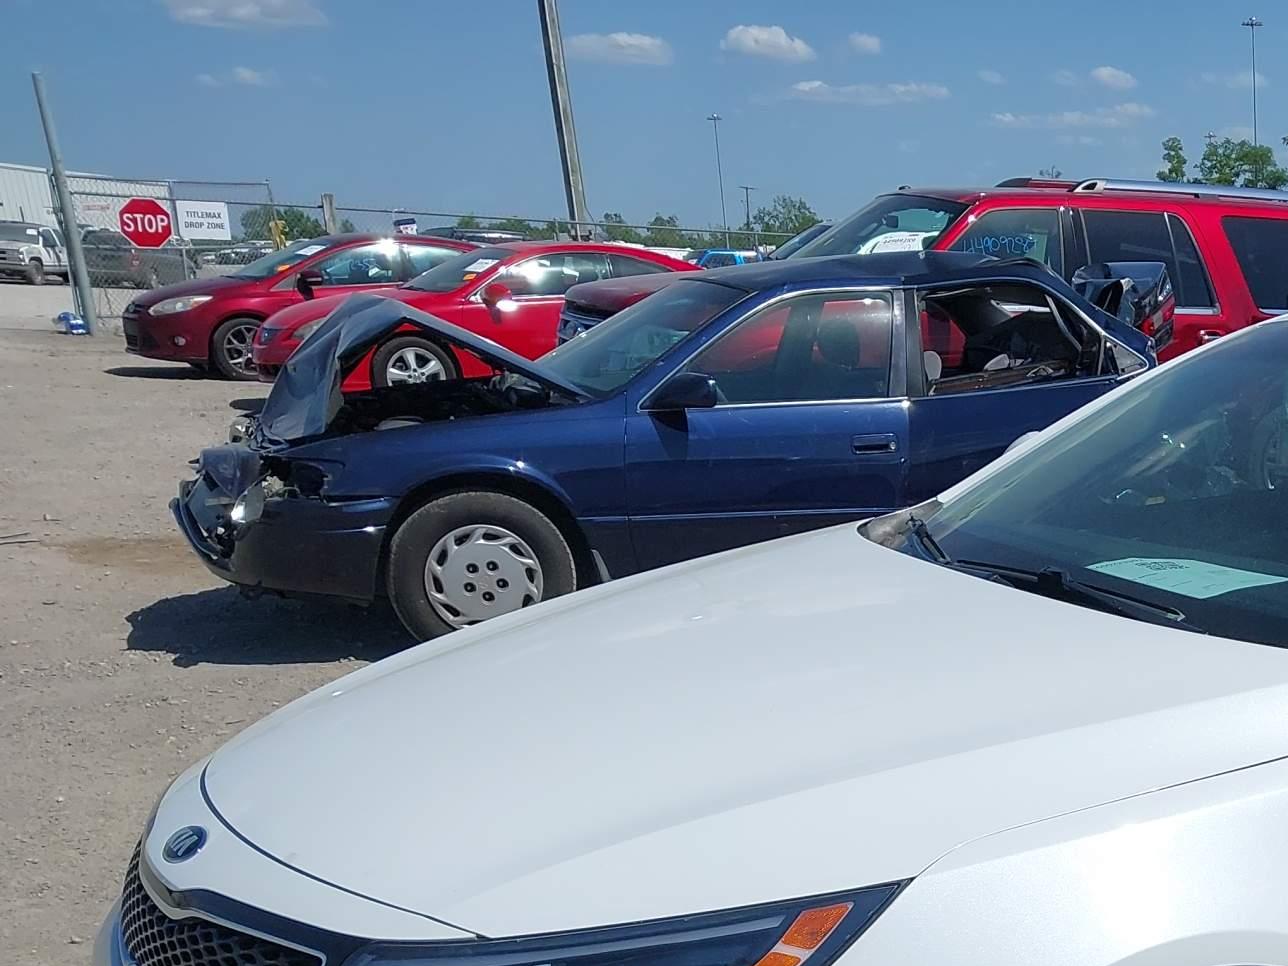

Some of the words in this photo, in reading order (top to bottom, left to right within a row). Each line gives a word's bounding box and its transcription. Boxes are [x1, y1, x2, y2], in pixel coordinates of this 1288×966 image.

[185, 210, 222, 219] TITLEMAX
[123, 213, 168, 233] STOP
[184, 221, 204, 229] DROP
[206, 221, 225, 230] ZONE
